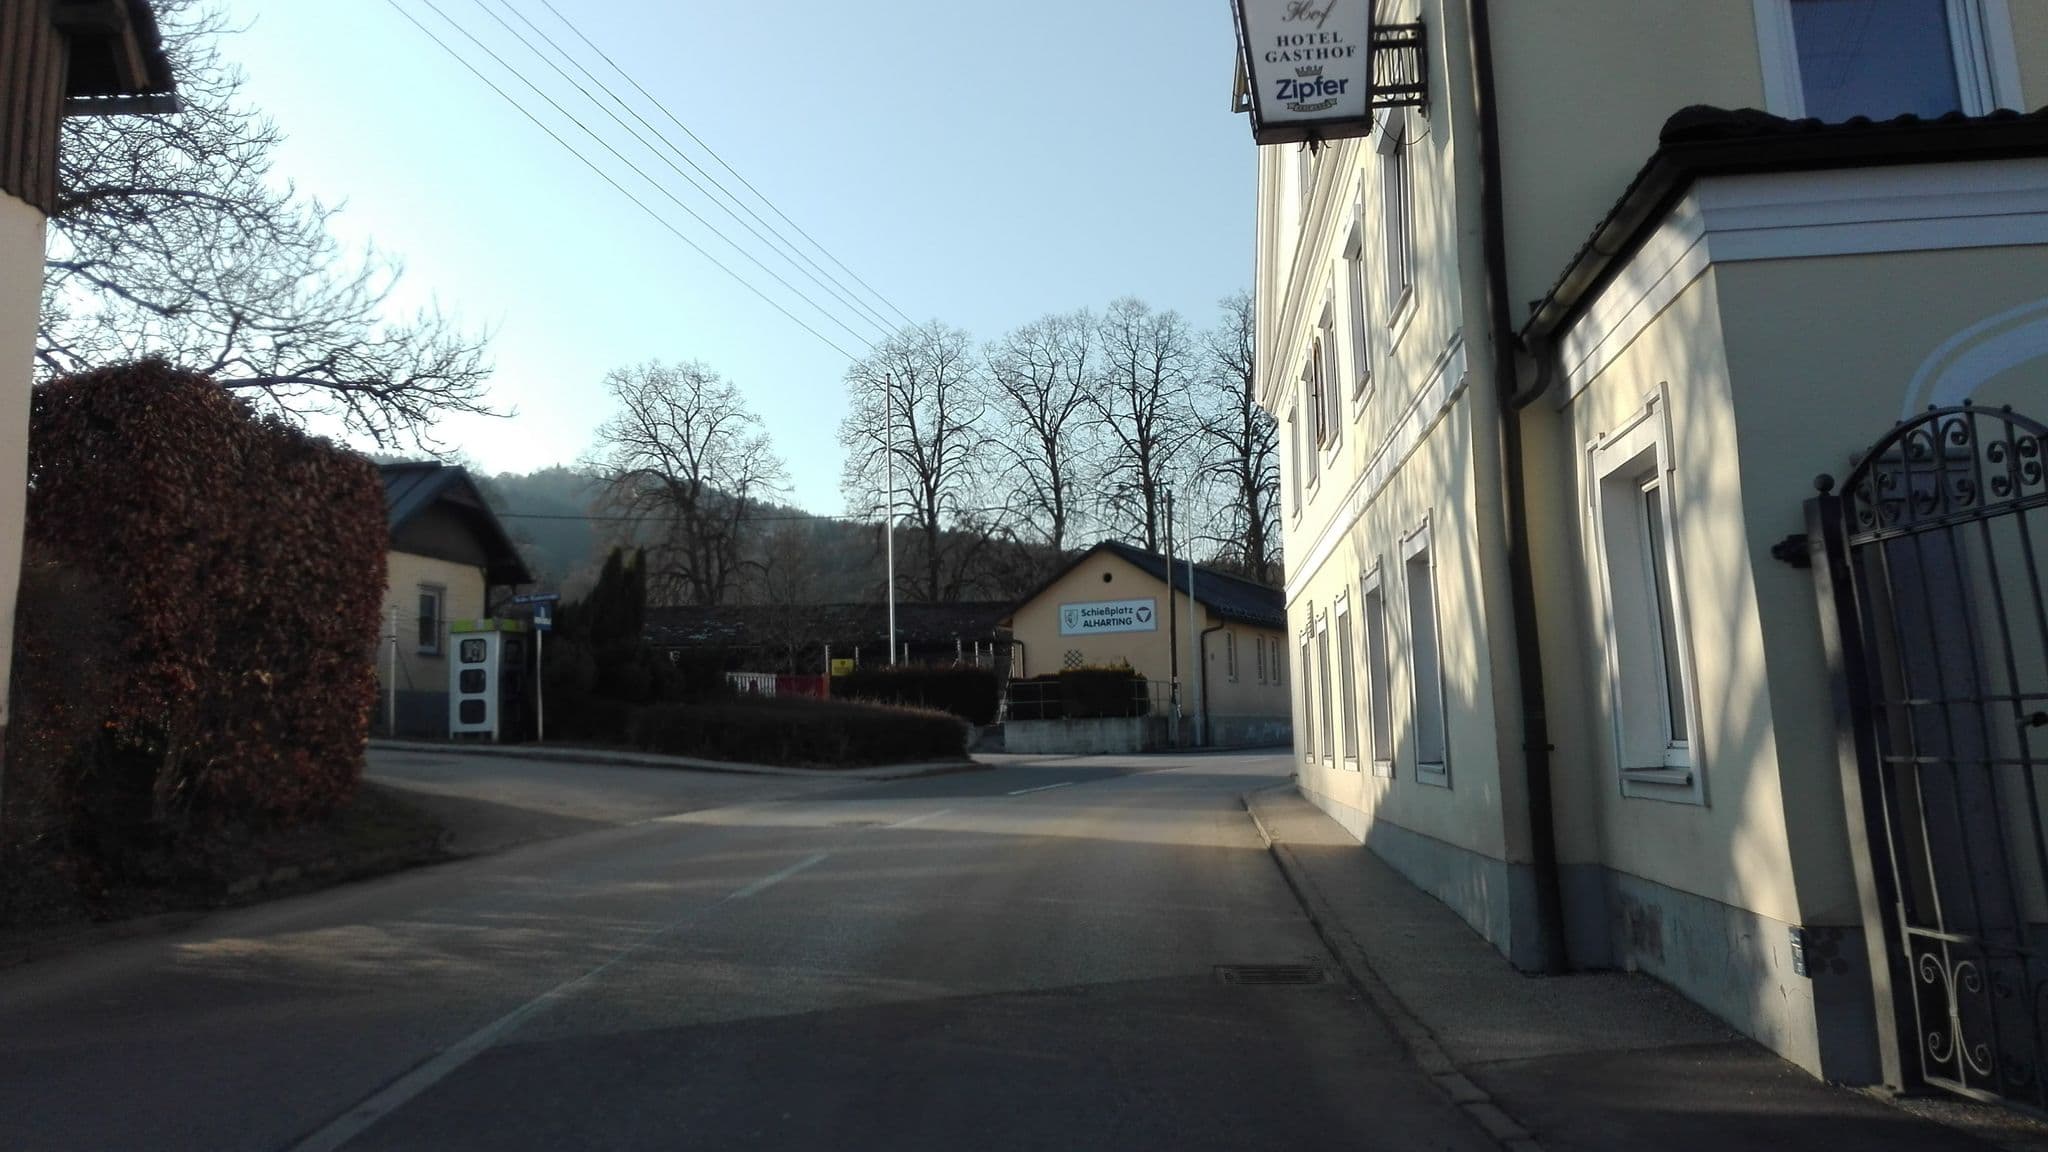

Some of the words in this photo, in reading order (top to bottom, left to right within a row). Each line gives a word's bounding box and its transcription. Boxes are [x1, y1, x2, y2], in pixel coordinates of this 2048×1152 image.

[1281, 0, 1336, 28] Hof
[1277, 31, 1343, 47] HOTEL
[1265, 46, 1357, 63] GASTHOF
[1276, 76, 1349, 103] Zipfer
[1081, 606, 1133, 617] Schießplatz
[1083, 617, 1132, 628] ALHARTING
